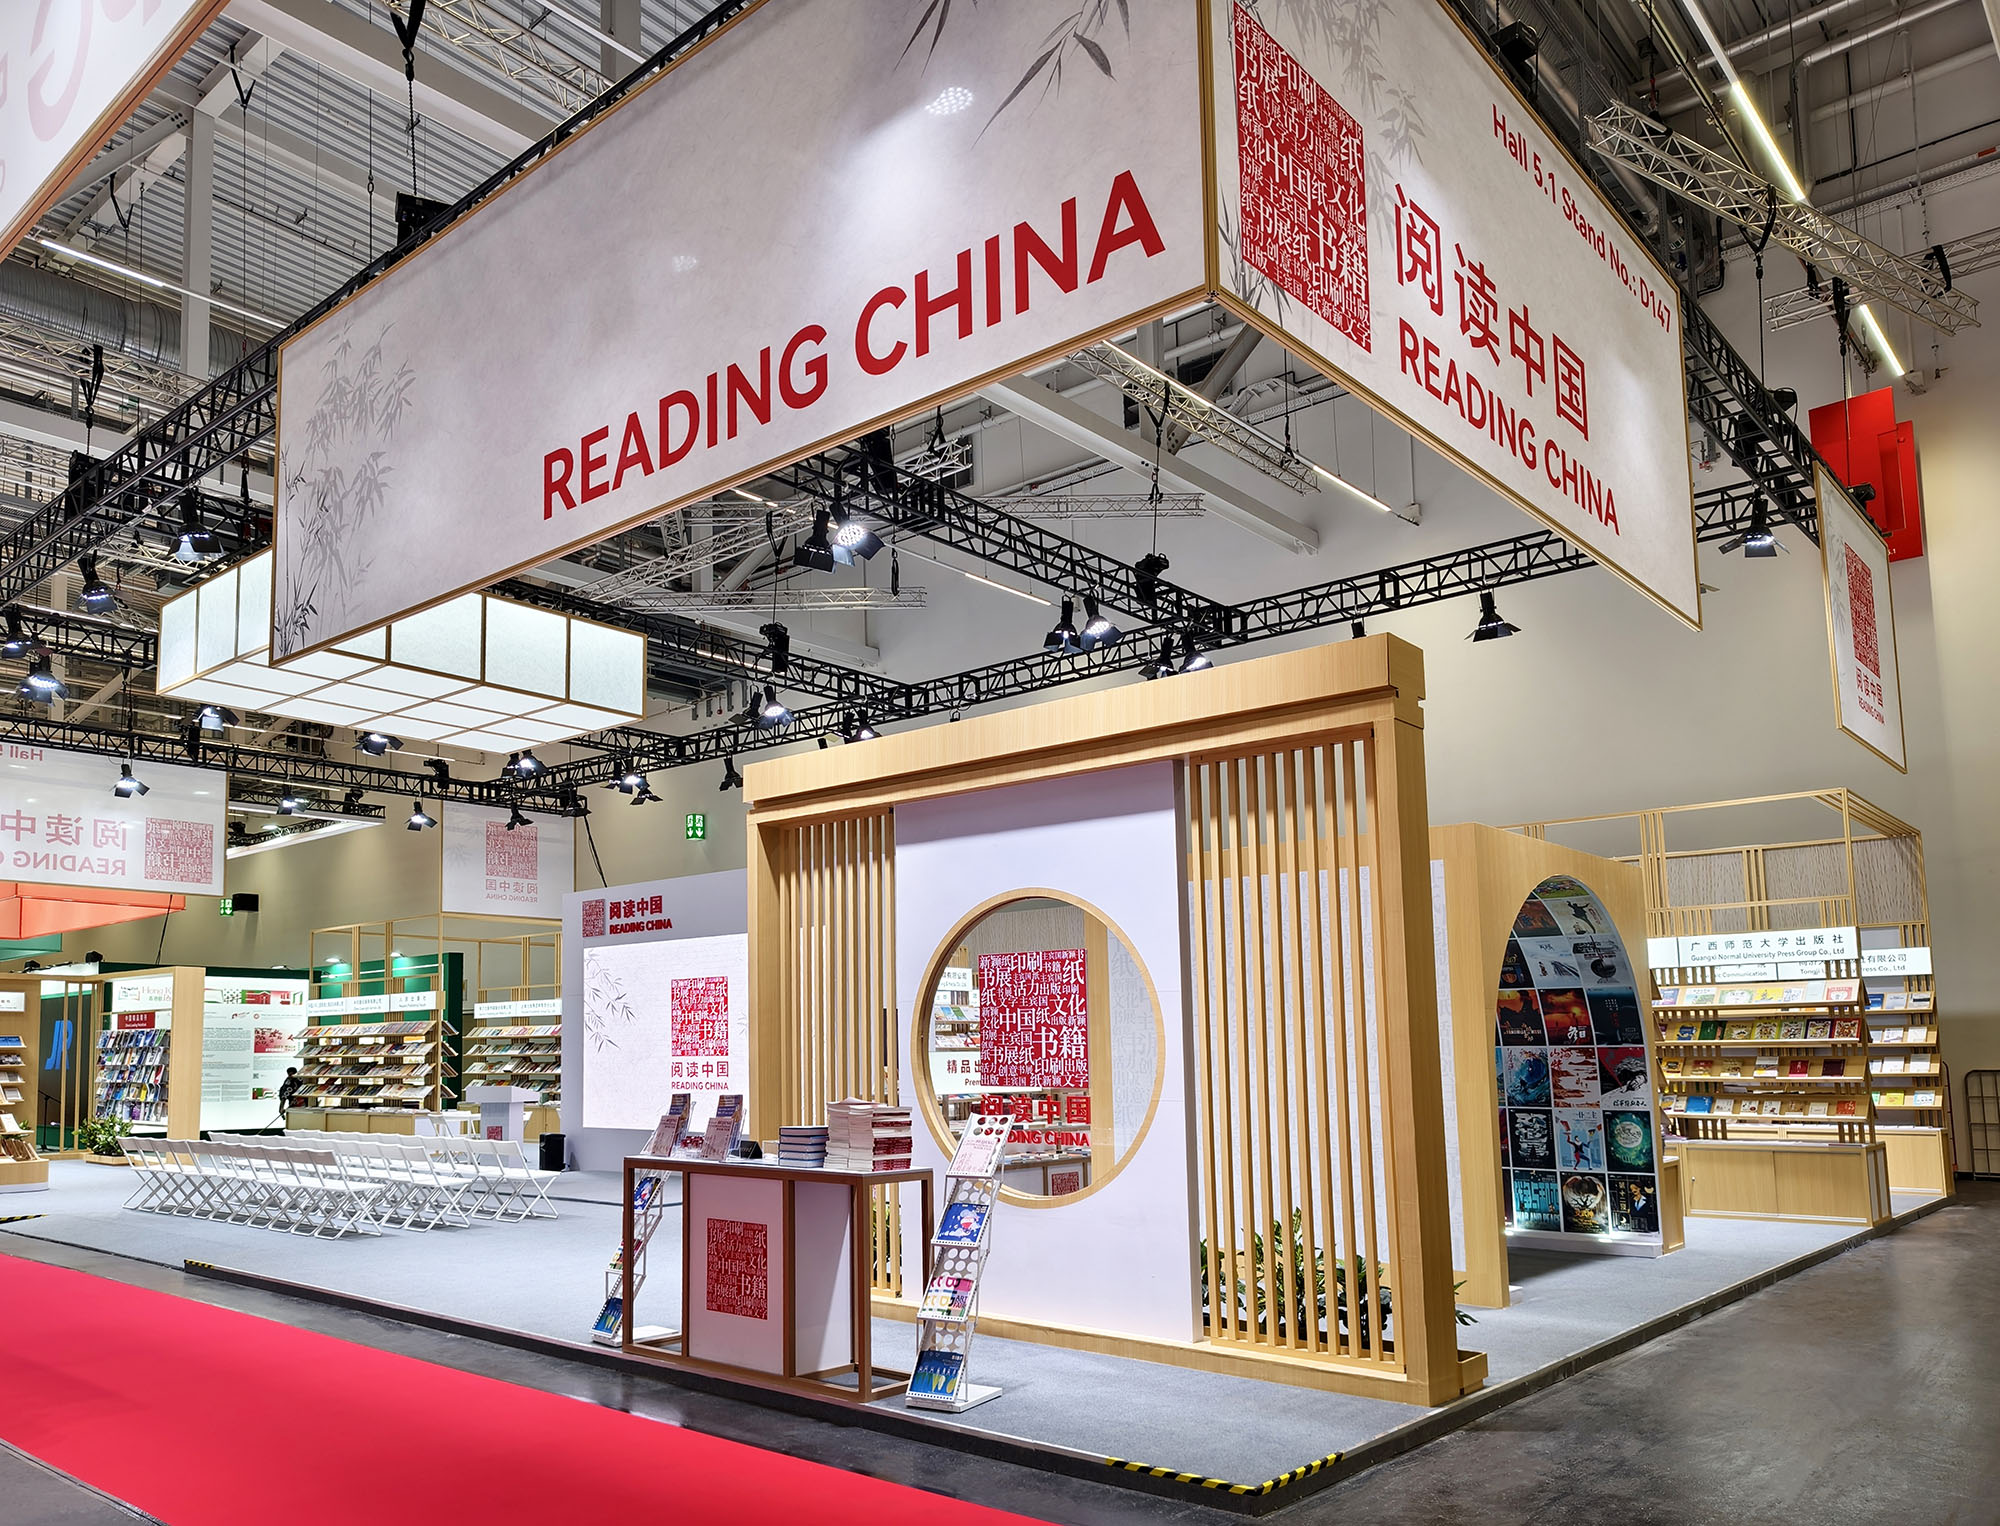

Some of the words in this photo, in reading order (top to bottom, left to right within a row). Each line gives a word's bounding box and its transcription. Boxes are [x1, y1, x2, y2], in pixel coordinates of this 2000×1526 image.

[1235, 36, 1281, 103] 书展
[1278, 50, 1317, 115] 印刷
[1239, 71, 1260, 120] 纸
[1340, 124, 1363, 182] 纸
[1266, 138, 1311, 210] 中国
[1312, 175, 1328, 213] 纸
[1327, 172, 1365, 232] 文化
[1264, 177, 1308, 232] 主宾国
[1254, 195, 1293, 254] 书展
[1492, 104, 1528, 172] Hall
[1533, 151, 1556, 204] 5.1
[1562, 187, 1606, 261] Stand
[1609, 241, 1637, 297] No.:
[1640, 277, 1671, 333] D147
[1243, 238, 1268, 273] 出版
[1293, 226, 1312, 270] 纸
[1309, 211, 1367, 301] 书籍
[1312, 261, 1345, 314] 印刷
[1307, 283, 1321, 316] 纸
[1346, 290, 1369, 325] 出版
[1394, 183, 1589, 441] 阅读中国
[1344, 312, 1371, 348] 文字
[543, 323, 828, 521] READING
[855, 169, 1166, 376] CHINA
[1399, 316, 1537, 471] READING
[1544, 438, 1620, 537] CHINA
[609, 895, 663, 920] 阅读中国
[609, 921, 645, 935] READING
[645, 918, 673, 932] CHINA
[1690, 933, 1844, 952] 广西师范大学出版社
[980, 954, 1000, 969] 新颖
[1011, 951, 1042, 973] 印刷
[1690, 953, 1717, 962] Guangxi
[1718, 952, 1742, 960] Normal
[1742, 950, 1776, 960] University
[1777, 949, 1796, 957] Press
[1796, 948, 1818, 957] Group
[1818, 947, 1832, 956] Co.,
[1832, 947, 1845, 955] Ltd
[980, 966, 1012, 988] 书展
[1063, 959, 1085, 985] 纸
[1722, 970, 1768, 979] Communication
[1800, 968, 1821, 976] Tongji
[981, 987, 997, 1006] 纸
[1014, 980, 1040, 997] 活力
[1040, 982, 1061, 996] 出版
[998, 995, 1019, 1008] 文字
[1020, 995, 1048, 1007] 主宾国
[1049, 994, 1086, 1016] 文化
[682, 1010, 701, 1025] 中国
[982, 1017, 1000, 1030] 文化
[999, 1008, 1036, 1032] 中国
[1036, 1007, 1050, 1024] 纸
[701, 1020, 728, 1041] 书籍
[998, 1031, 1032, 1046] 主宾国
[1033, 1026, 1087, 1059] 书籍
[981, 1047, 991, 1061] 纸
[990, 1046, 1019, 1065] 书展
[1019, 1046, 1035, 1065] 纸
[671, 1060, 729, 1078] 阅读中国
[981, 1062, 998, 1074] 活力
[998, 1064, 1019, 1077] 创意
[1035, 1057, 1064, 1075] 印刷
[1064, 1058, 1088, 1073] 出版
[671, 1081, 703, 1090] READING
[704, 1081, 729, 1090] CHINA
[981, 1074, 1000, 1086] 出版
[1030, 1072, 1042, 1087] 纸
[1043, 1075, 1062, 1087] 新颖
[1063, 1073, 1089, 1087] 文字
[979, 1094, 1091, 1126] 阅读中国
[1005, 1129, 1042, 1146] DING
[1044, 1130, 1090, 1147] CHINA
[754, 1230, 766, 1249] 纸
[718, 1257, 739, 1277] 中国
[748, 1253, 767, 1270] 文化
[737, 1273, 767, 1299] 书籍
